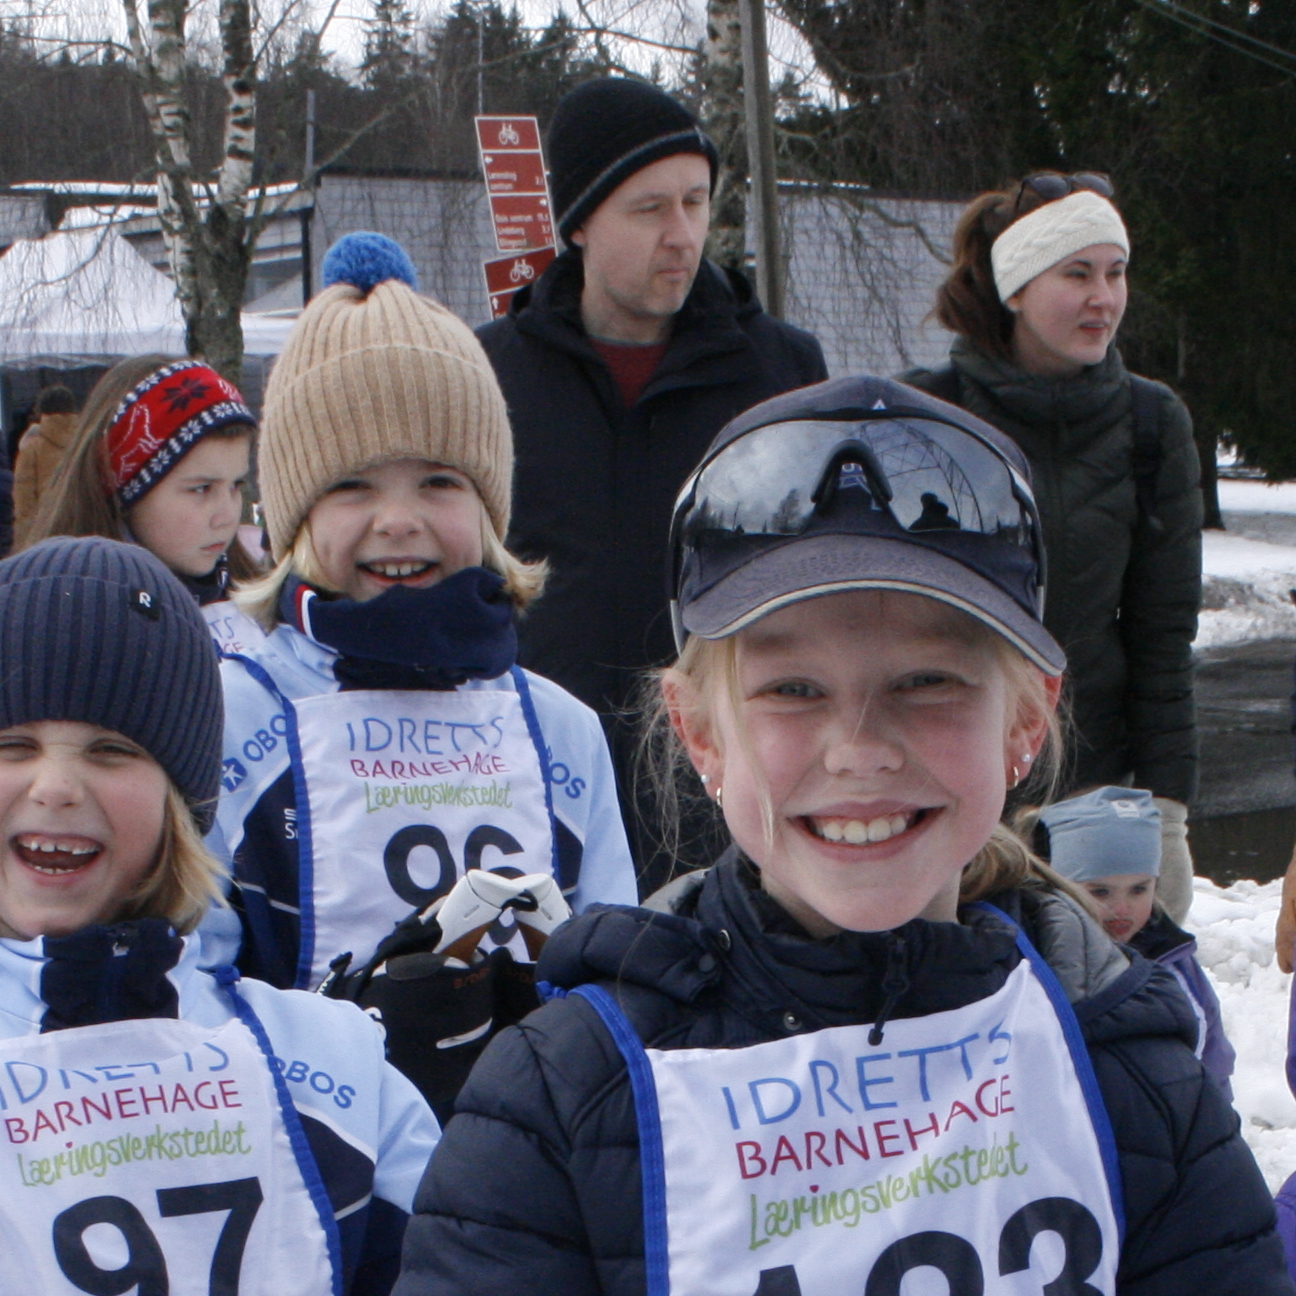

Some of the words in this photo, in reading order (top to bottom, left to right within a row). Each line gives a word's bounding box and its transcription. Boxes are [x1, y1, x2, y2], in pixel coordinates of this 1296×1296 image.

[242, 714, 288, 762] OBO
[346, 716, 505, 755] IDRETTS
[350, 751, 510, 779] BARNEHAGE
[721, 1022, 1013, 1130] IDRETTS
[5, 1079, 243, 1144] BARNEHAGE
[735, 1074, 1014, 1180] BARNEHAGE
[17, 1120, 251, 1187] Læringsverkstedet
